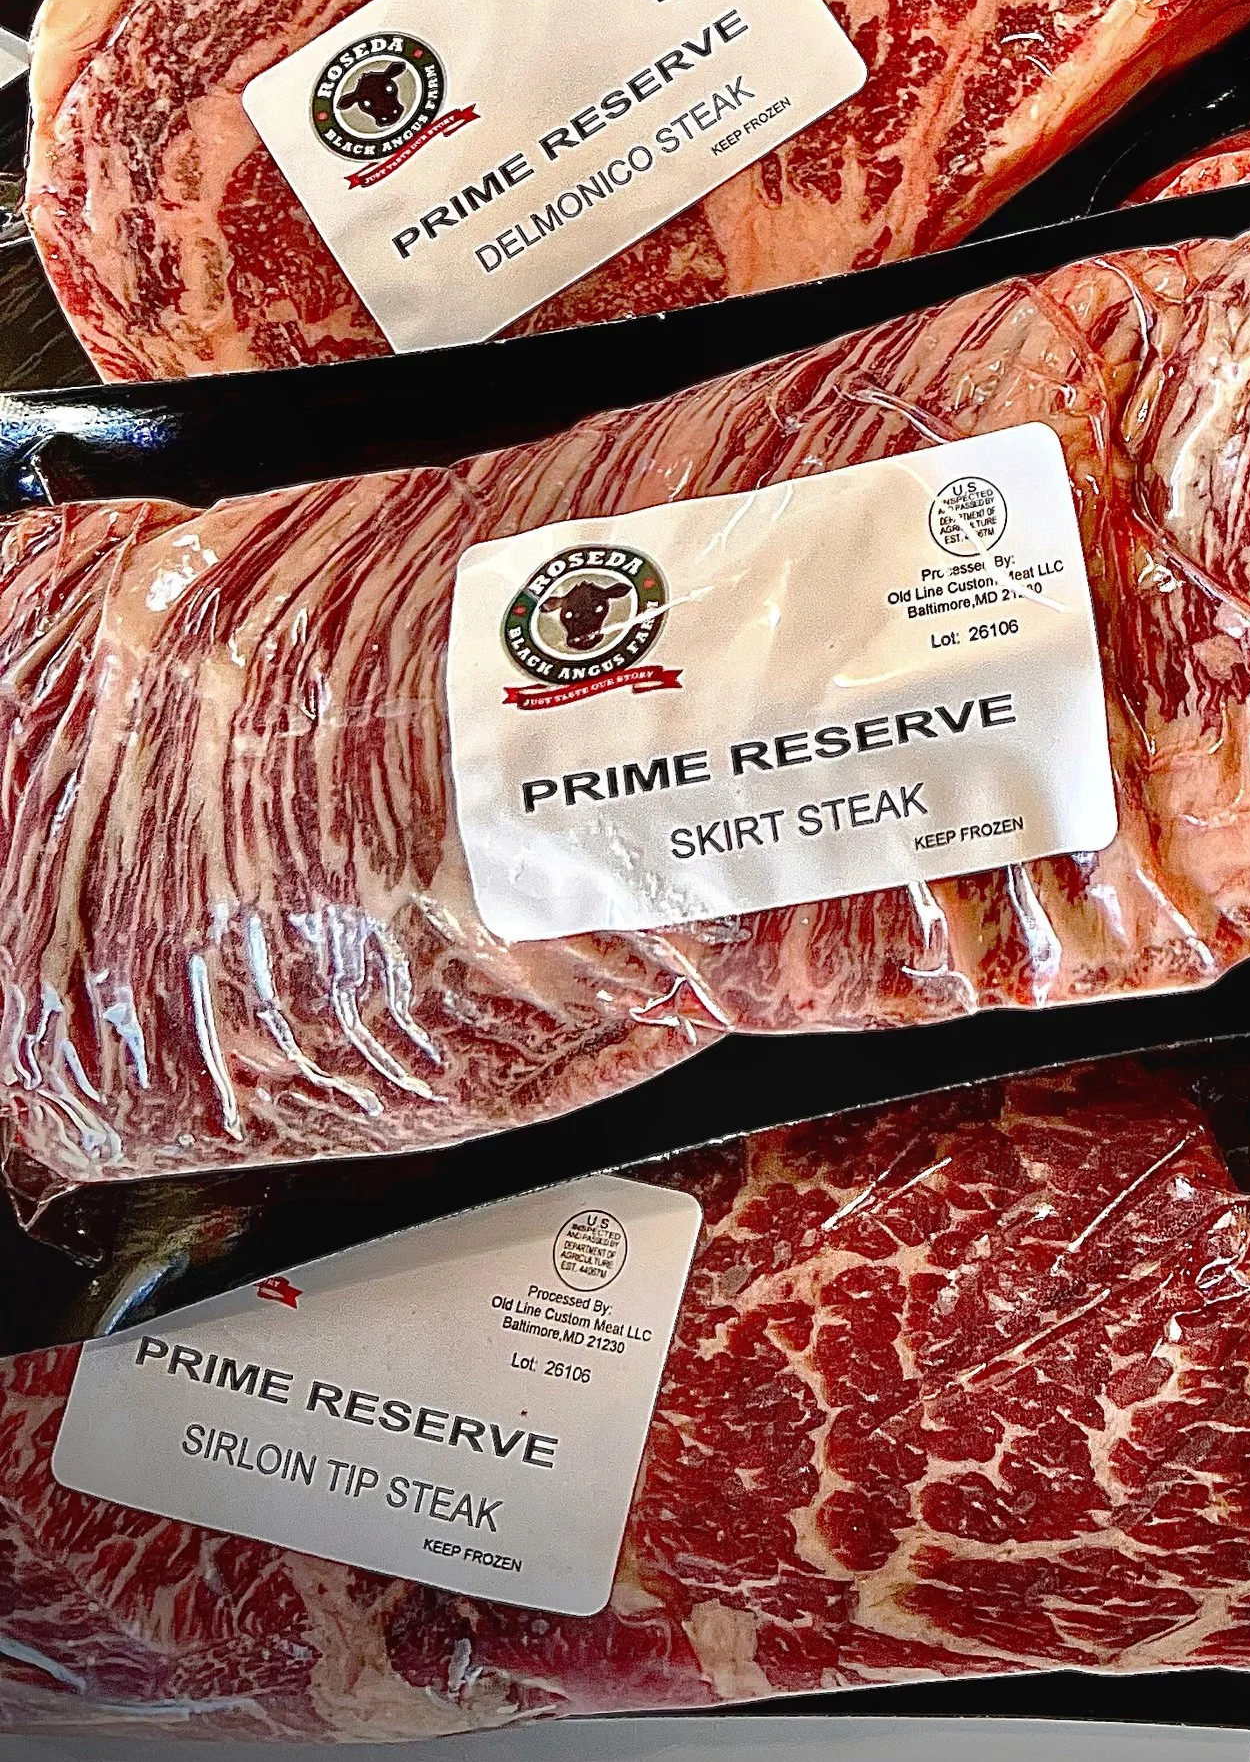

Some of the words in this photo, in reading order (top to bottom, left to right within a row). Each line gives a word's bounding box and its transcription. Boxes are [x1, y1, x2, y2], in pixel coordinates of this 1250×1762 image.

[316, 34, 406, 101] ROSEDA
[392, 153, 534, 259] PRIME
[539, 10, 748, 161] RESERVE
[710, 126, 744, 157] KEEP
[743, 97, 792, 132] FROZEN
[475, 146, 652, 272] DELMONICO
[656, 76, 755, 153] STEAK
[527, 550, 644, 596] ROSEDA
[994, 554, 1016, 571] By:
[888, 590, 911, 604] Old
[916, 587, 943, 600] Line
[907, 590, 998, 619] Baltimore,MD
[508, 626, 553, 676] BLACK
[557, 653, 625, 681] ANGUS
[931, 632, 960, 648] Lot:
[969, 620, 1018, 641] 26106
[522, 751, 710, 813] PRIME
[731, 694, 1016, 776] RESERVE
[671, 810, 784, 858] SKIRT
[798, 782, 928, 836] STEAK
[915, 830, 956, 850] KEEP
[961, 817, 1023, 841] FROZEN
[492, 1296, 514, 1311] Old
[516, 1300, 541, 1317] Line
[545, 1308, 590, 1328] Custom
[594, 1318, 624, 1336] Meat
[627, 1326, 652, 1341] LLC
[528, 1285, 591, 1309] Processed
[587, 1336, 624, 1353] 21230
[511, 1353, 537, 1371] Lot:
[544, 1361, 591, 1383] 26106
[136, 1333, 293, 1404] PRIME
[306, 1381, 558, 1468] RESERVE
[182, 1424, 317, 1485] SIRLOIN
[328, 1459, 378, 1497] TIP
[386, 1477, 503, 1532] STEAK
[423, 1538, 464, 1559] KEEP
[464, 1548, 522, 1572] FROZEN
